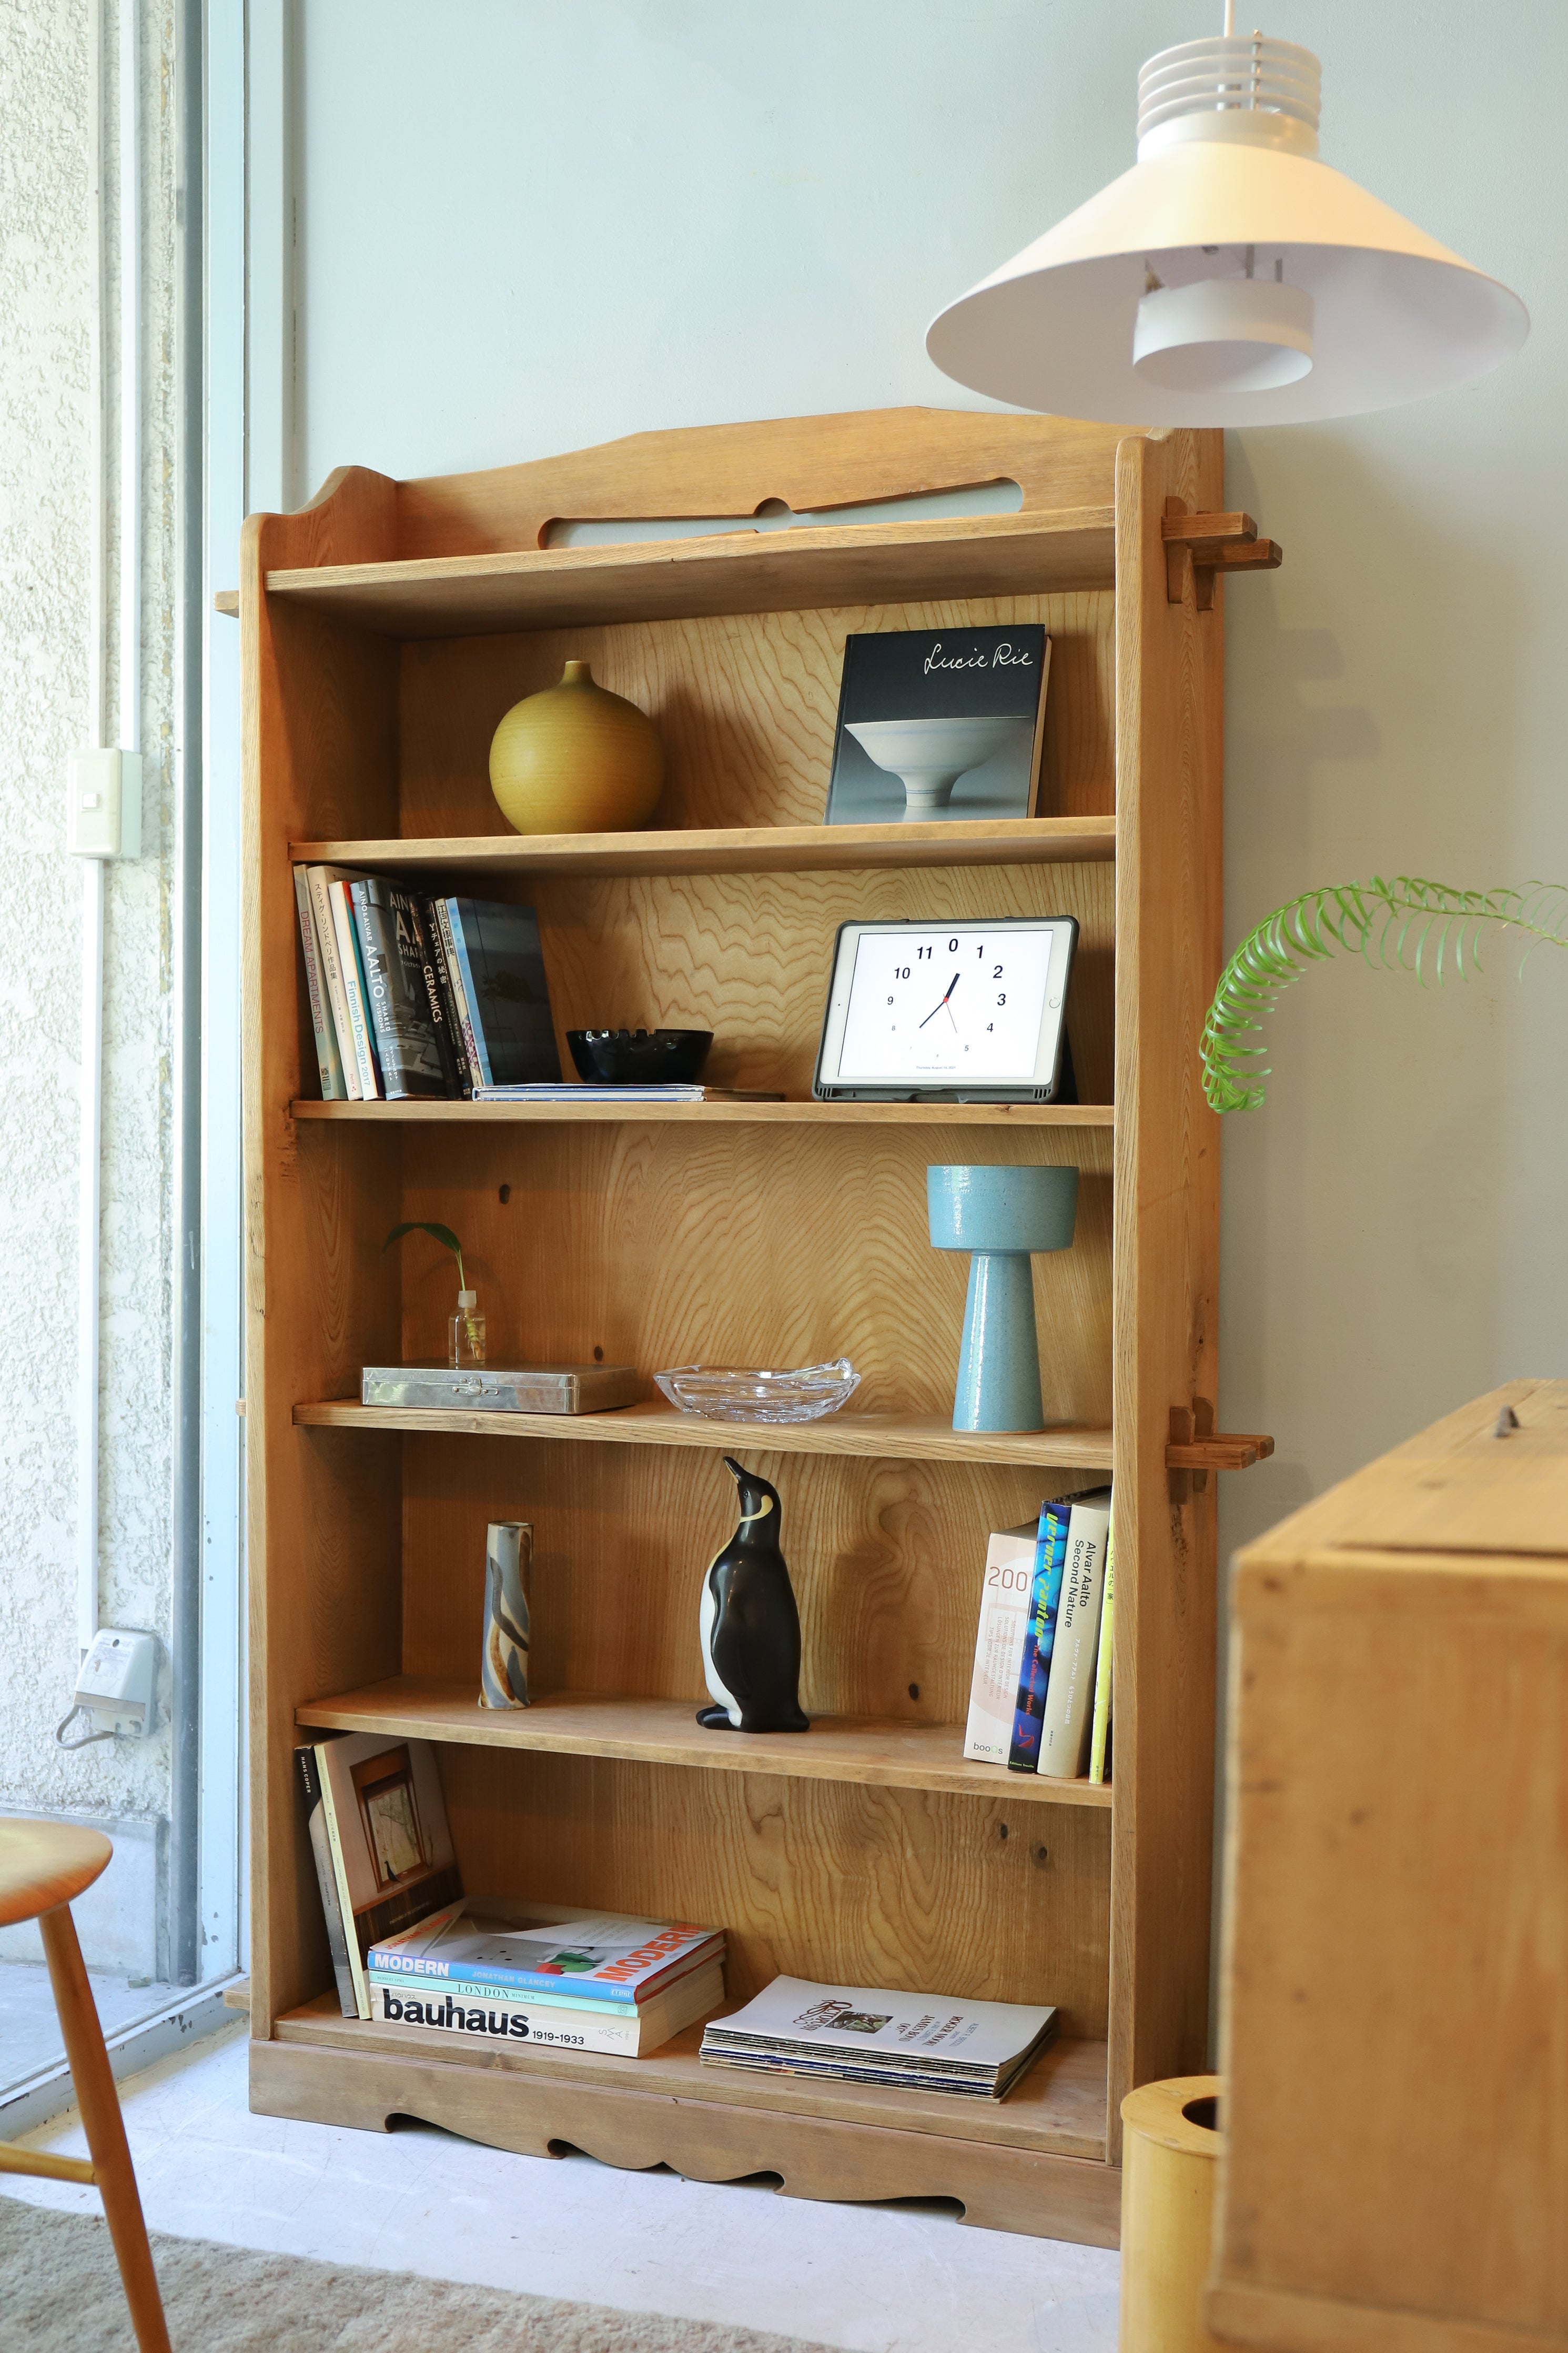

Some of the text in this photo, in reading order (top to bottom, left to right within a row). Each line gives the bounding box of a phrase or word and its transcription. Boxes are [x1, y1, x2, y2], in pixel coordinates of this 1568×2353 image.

[924, 643, 1033, 675] Lucie Rie
[316, 884, 338, 979] スティグ・リンドベリ作品集
[949, 939, 958, 952] 0
[429, 923, 447, 984] Yチェアの秘密
[917, 947, 932, 959] 11
[977, 946, 983, 959] 1
[301, 911, 323, 1033] DREAM APARTMENTS
[366, 945, 385, 998] AALTO
[894, 968, 910, 979] 10
[993, 966, 1003, 978] 2
[423, 965, 442, 1024] CERAMICS
[887, 997, 893, 1005] 9
[997, 993, 1006, 1005] 3
[376, 1002, 385, 1033] VISIONS
[381, 1001, 390, 1031] SHARED
[987, 1023, 993, 1032] 4
[348, 980, 370, 1085] Finnish Design 2017
[988, 1566, 1027, 1591] 200
[1065, 1540, 1084, 1628] Second Nature
[1079, 1542, 1096, 1607] Alvar Aalto
[988, 1654, 998, 1697] RAUMGESTALTUNG
[1029, 1660, 1038, 1692] Collected
[375, 1954, 449, 1977] MODERN
[593, 1923, 707, 1982] MODERN
[458, 1984, 509, 1999] LONDON
[472, 1971, 555, 1988] JONATHAN GLANCEY
[382, 1988, 584, 2045] bauhaus 1919-1933
[898, 2015, 935, 2042] JAMES BOND
[922, 2016, 964, 2046] ROGER MOORE
